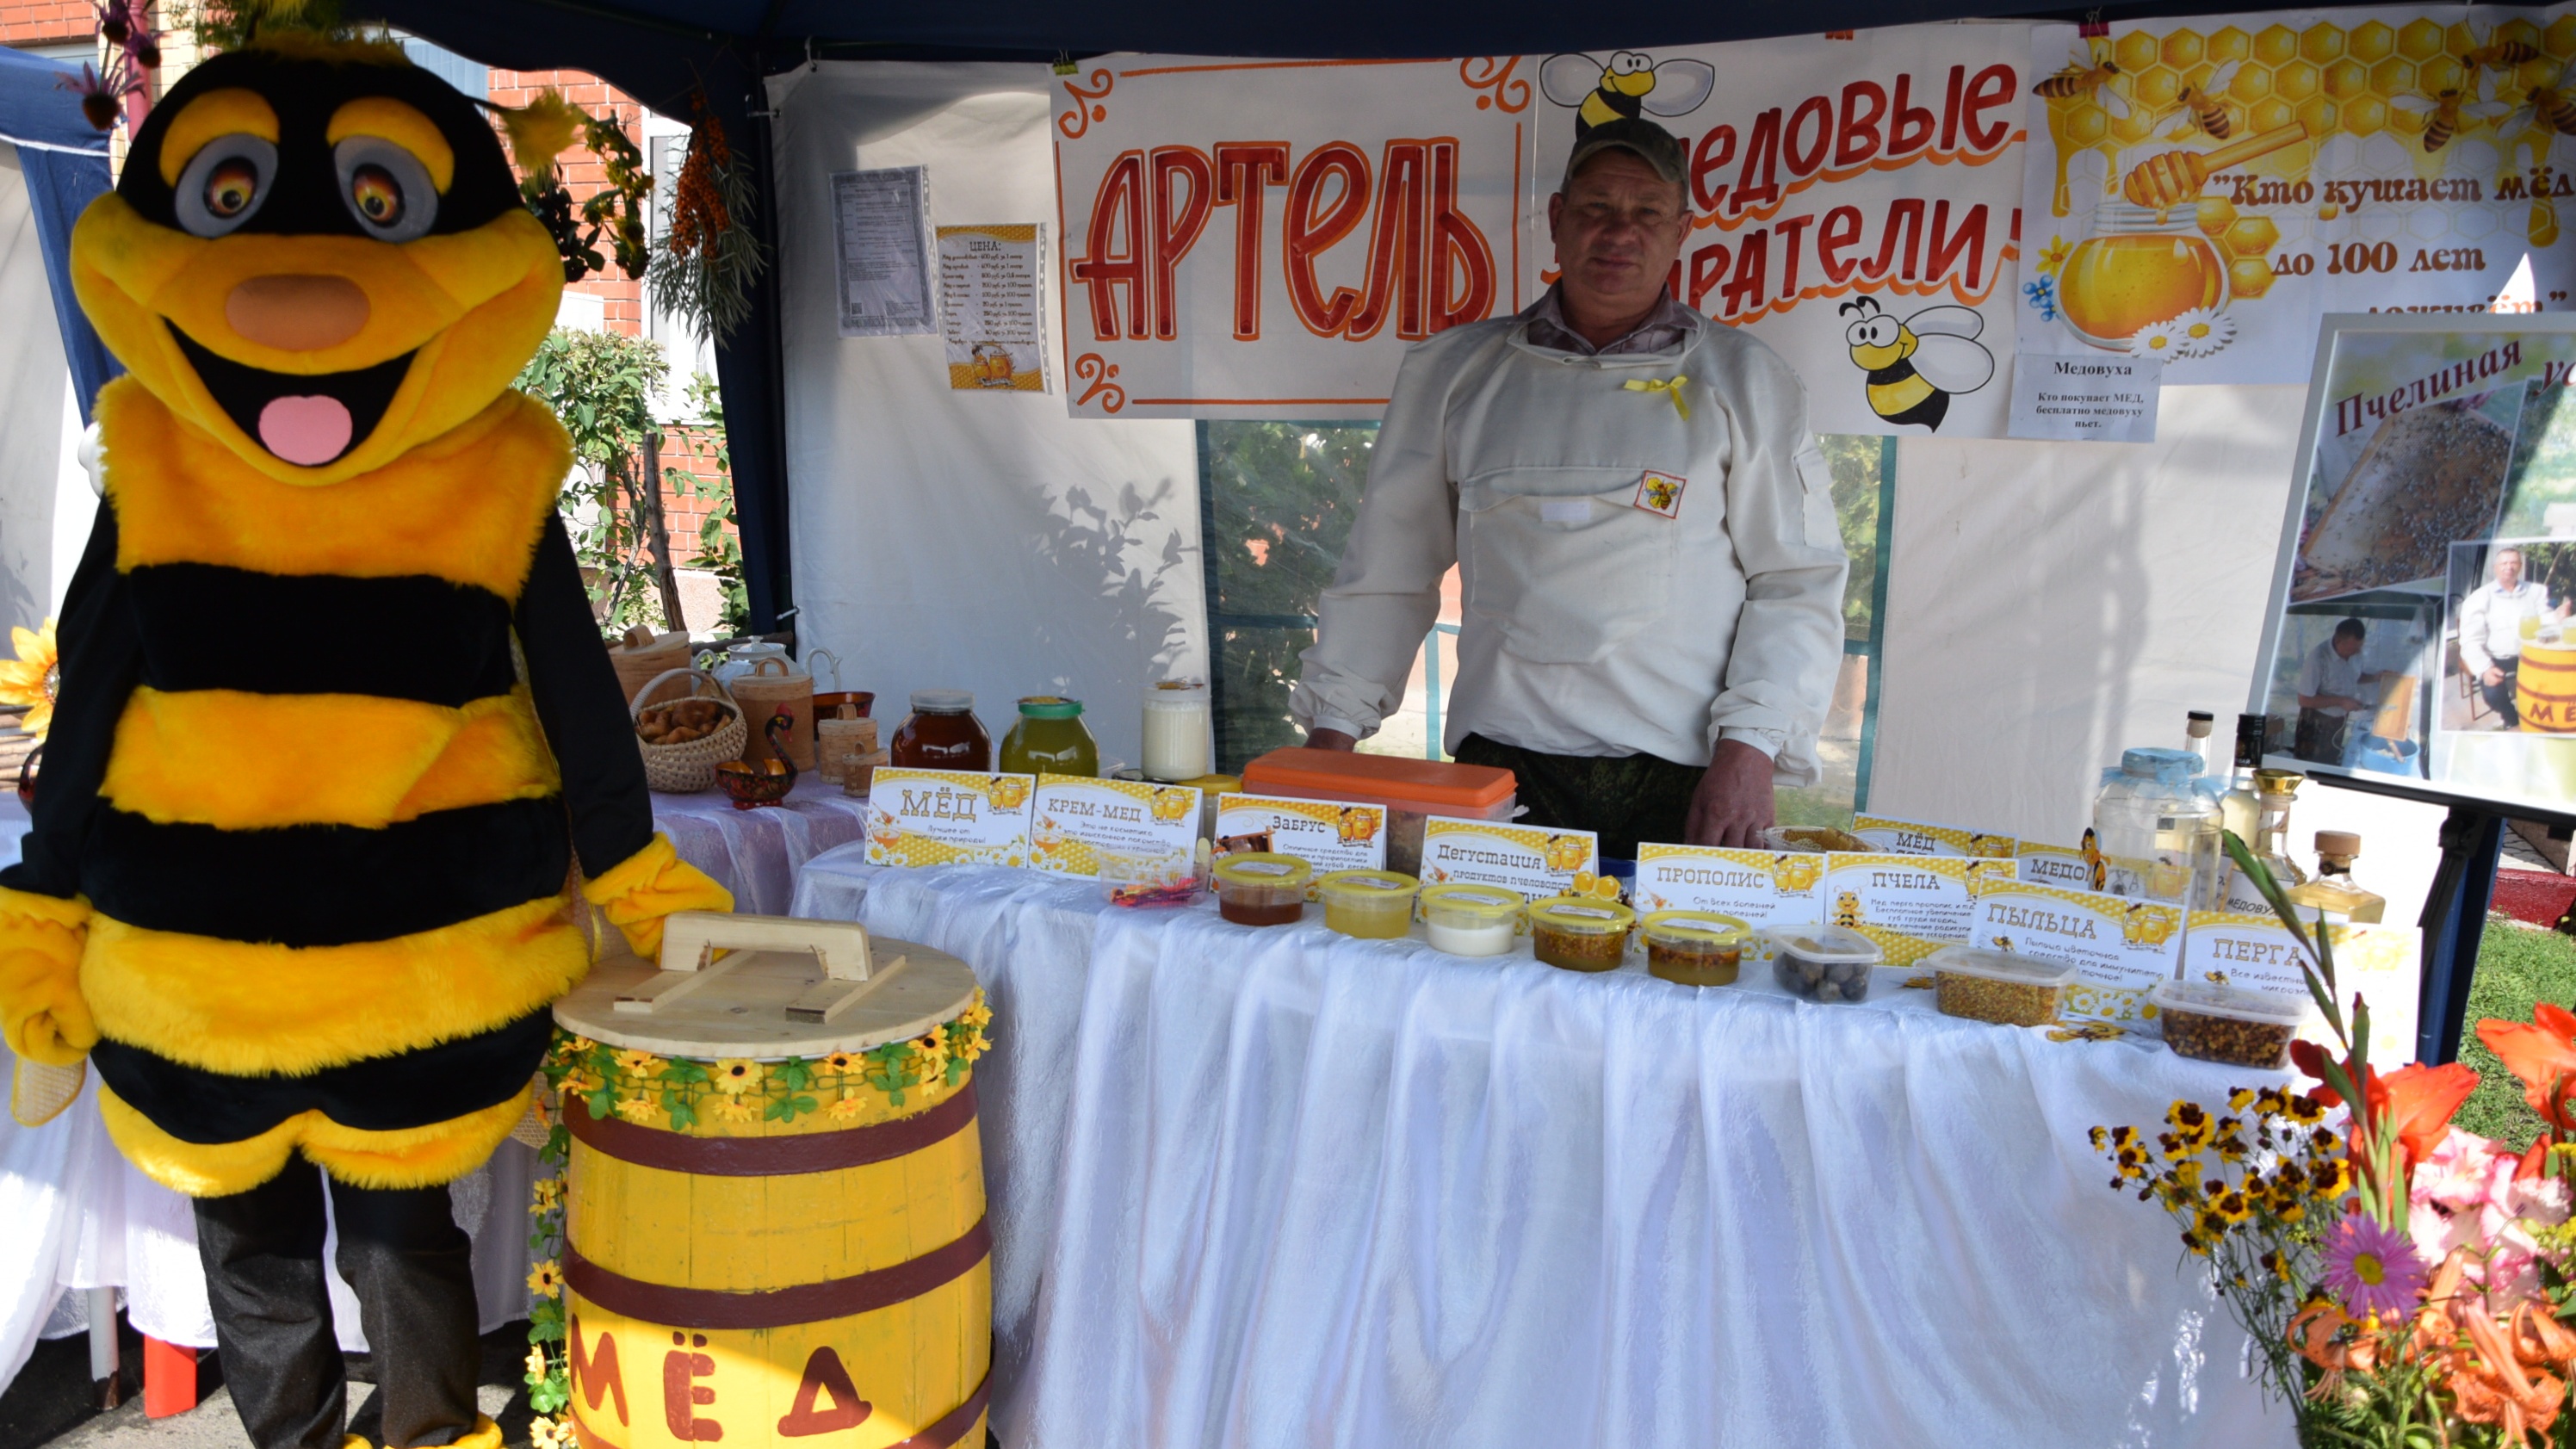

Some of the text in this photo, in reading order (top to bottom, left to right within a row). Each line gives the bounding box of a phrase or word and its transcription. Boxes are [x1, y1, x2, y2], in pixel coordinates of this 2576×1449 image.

[1680, 63, 2017, 214] ЕДОВЫЕ
[2323, 176, 2482, 214] кушает
[969, 241, 1000, 251] ЦЕНА:
[1069, 136, 1496, 341] АРТЕЛЬ
[2270, 241, 2486, 276] до 100 лет
[2054, 362, 2132, 378] Медовуха
[2038, 392, 2058, 402] Кто
[2060, 393, 2110, 404] покупает
[2336, 339, 2523, 437] Пчелиная
[2036, 406, 2143, 418] бесплатно медовуху
[900, 786, 977, 823] МЁД
[1048, 798, 1142, 823] КРЕМ-МЕД
[927, 824, 957, 834] Лучшее
[1081, 820, 1096, 829] Это
[1283, 843, 1318, 852] Отличное
[1897, 833, 1935, 852] МЁД
[1437, 844, 1541, 870] Дегустация
[1453, 869, 1572, 891] продуктов пчеловодст
[1656, 866, 1764, 889] ПРОПОЛИС
[1872, 872, 1940, 890] ПЧЕЛА
[1693, 896, 1708, 905] От
[1733, 900, 1775, 909] болезней
[1987, 903, 2096, 939] ПЫЛЬЦА
[2025, 937, 2061, 951] Пыльца
[2064, 944, 2120, 961] цветочная
[2213, 938, 2302, 967] ПЕРГА
[2028, 950, 2076, 964] средство
[2100, 963, 2164, 979] иммунитета
[2231, 968, 2250, 978] Все
[570, 1313, 873, 1442] МЁД
